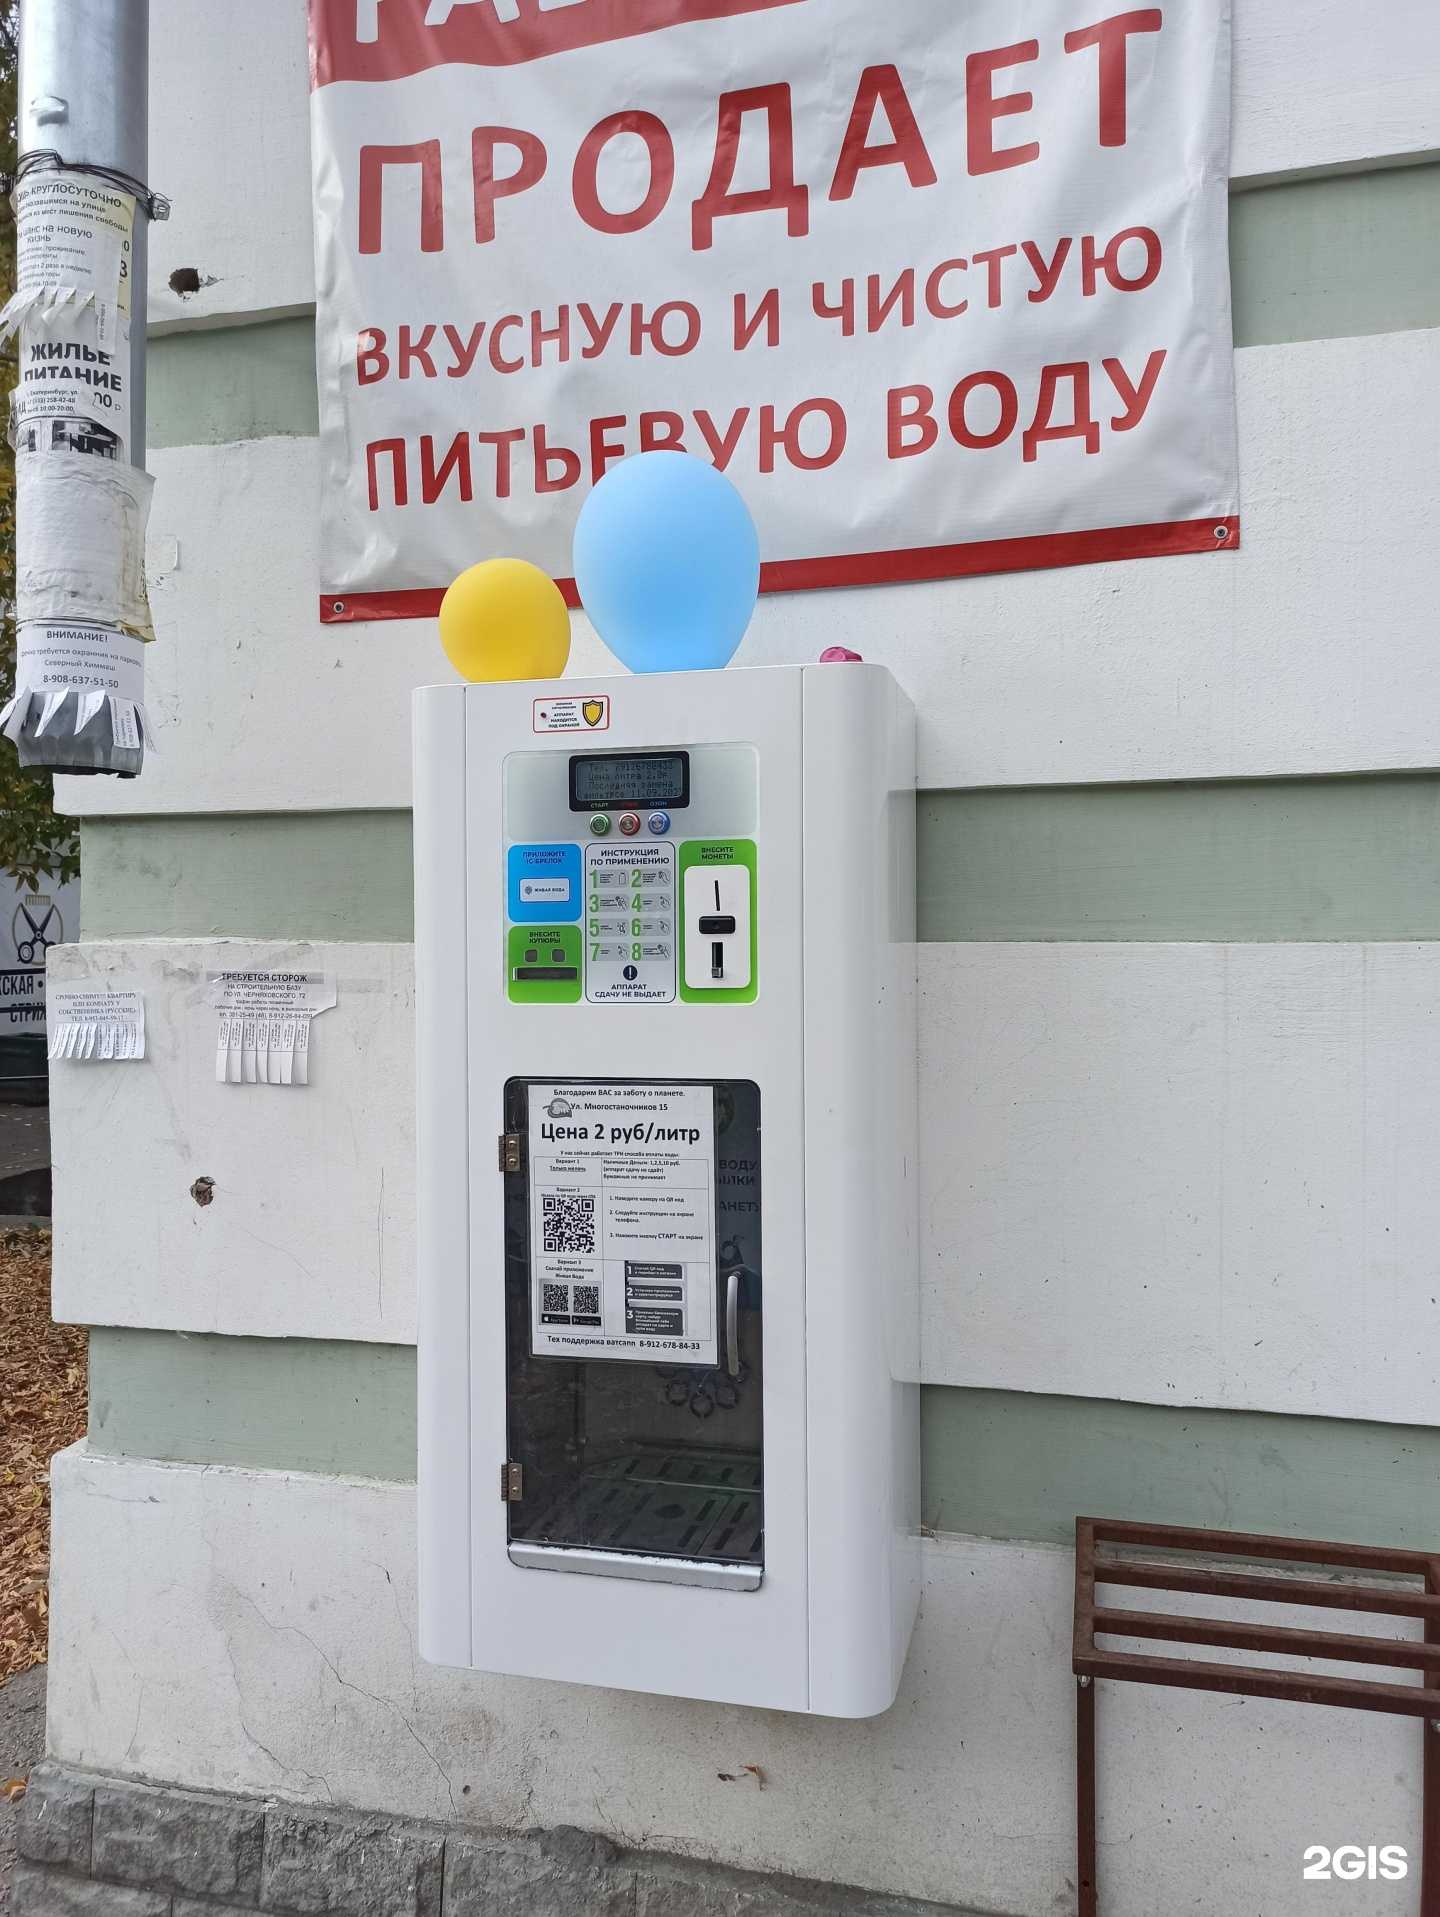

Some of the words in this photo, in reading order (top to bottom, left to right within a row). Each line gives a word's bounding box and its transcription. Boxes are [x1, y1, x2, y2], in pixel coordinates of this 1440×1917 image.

[359, 8, 1163, 254] ПРОДАЕТ
[31, 184, 122, 208] КРУГЛОСУТОЧНО
[57, 226, 93, 239] новую
[357, 300, 702, 386] ВКУСНУЮ
[733, 288, 780, 351] И
[812, 226, 1163, 337] ЧИСТУЮ
[31, 342, 111, 366] ЖИЛЬЕ
[887, 349, 1168, 463] ВОДУ
[46, 630, 108, 643] ВНИМАНИЕ!
[43, 674, 119, 689] 8-908-637-51-50
[601, 848, 659, 857] ИНСТРУКЦИЯ
[605, 857, 670, 866] ПРИМЕНЕНИЮ
[589, 869, 598, 889] 1
[631, 868, 642, 888] 2
[589, 894, 600, 913] 3
[631, 893, 642, 913] 4
[589, 918, 600, 937] 5
[631, 918, 642, 937] 6
[589, 942, 600, 962] 7
[631, 942, 642, 961] 8
[0, 974, 34, 996] СКАЯ
[221, 972, 270, 982] ТРЕБУЕТСЯ
[271, 973, 308, 983] СТОРОЖ
[553, 1089, 597, 1098] Благодарим
[623, 1089, 647, 1098] заботу
[654, 1090, 685, 1098] планете.
[571, 1103, 583, 1111] Ул.
[584, 1103, 657, 1111] Многостаночников
[659, 1103, 668, 1111] 15
[541, 1123, 589, 1143] Цена
[594, 1123, 605, 1140] 2
[610, 1121, 701, 1145] руб/литр
[626, 1266, 632, 1275] 1
[626, 1287, 633, 1296] 2
[626, 1310, 634, 1319] 3
[547, 1335, 560, 1343] Тех
[562, 1336, 604, 1347] поддержка
[606, 1339, 636, 1347] ватсапп
[639, 1340, 700, 1350] 8-912-678-84-33
